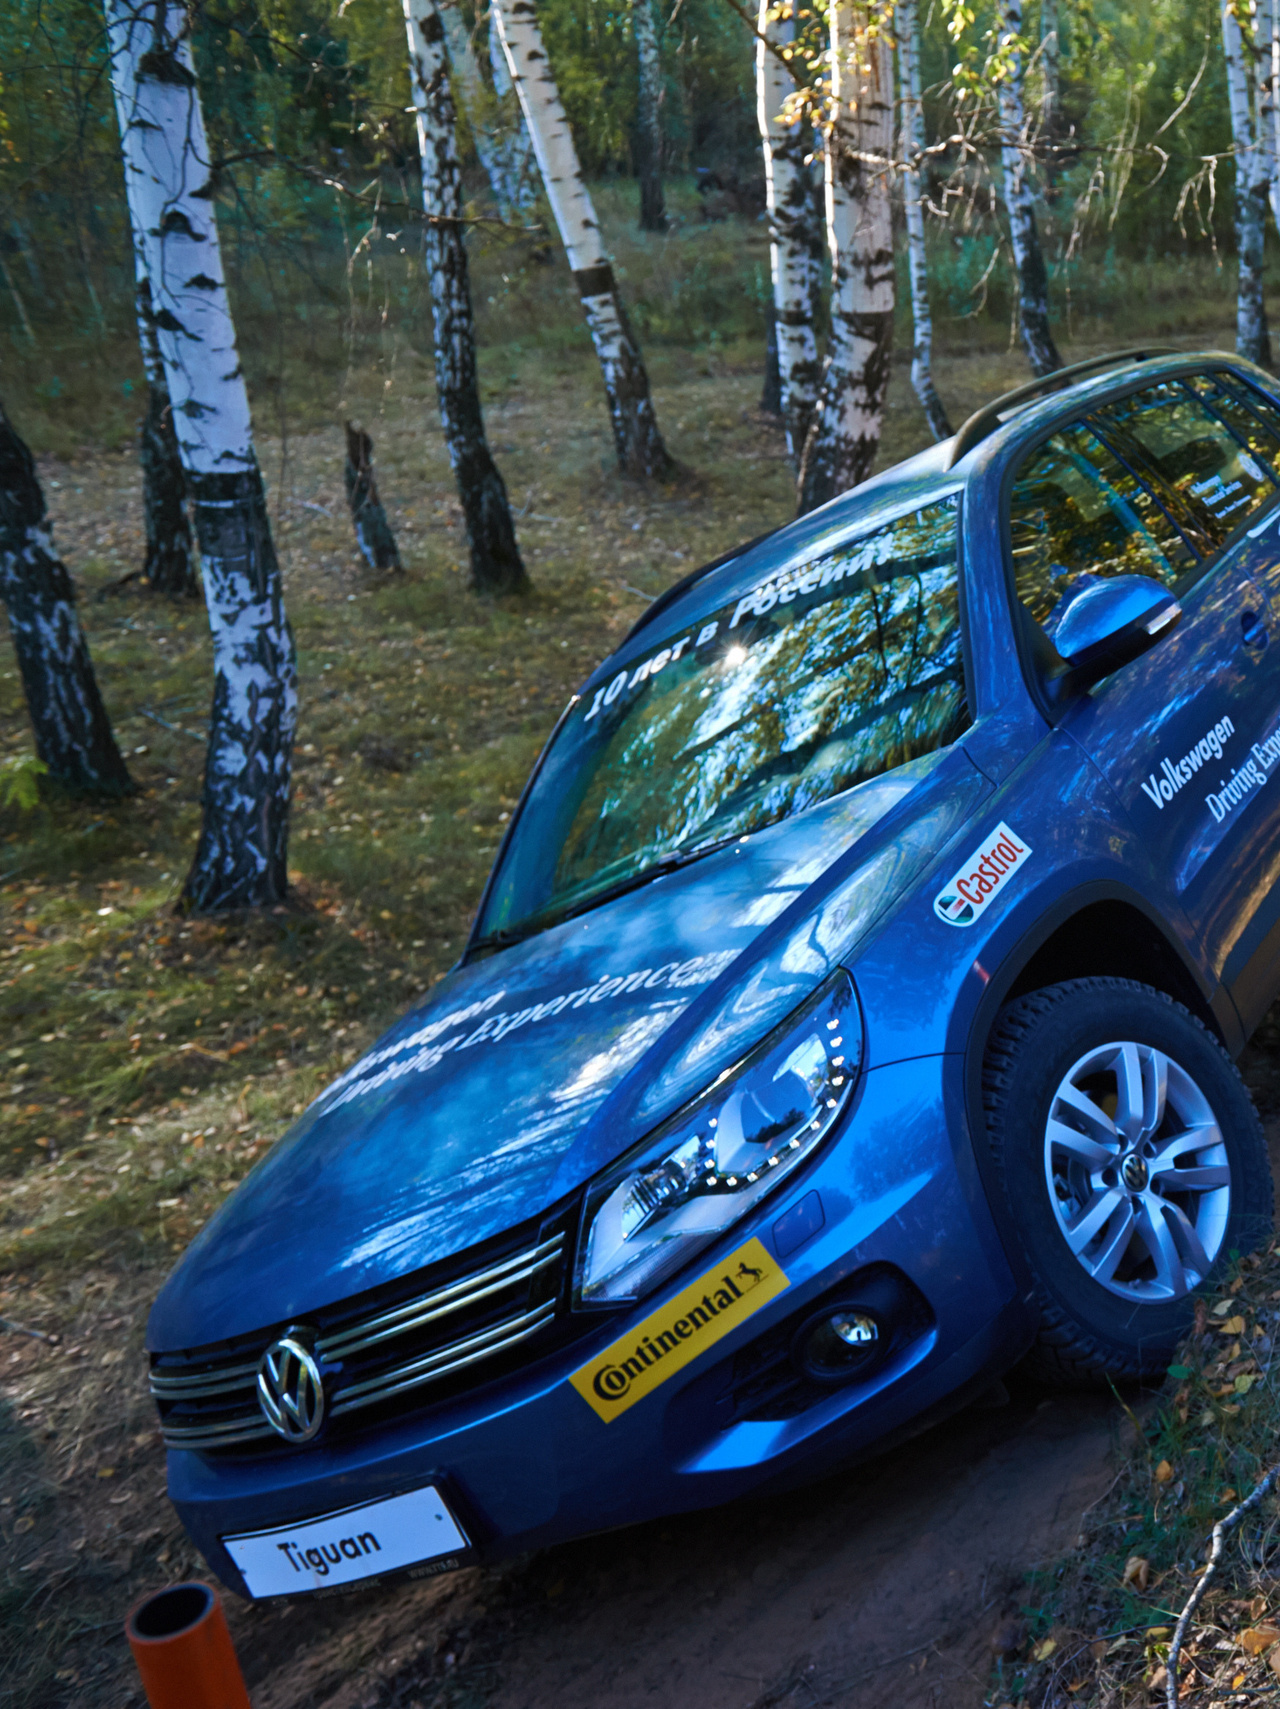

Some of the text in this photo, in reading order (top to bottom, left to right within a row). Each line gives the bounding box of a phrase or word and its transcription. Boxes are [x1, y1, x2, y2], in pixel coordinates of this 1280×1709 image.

[584, 670, 628, 722] 10
[627, 636, 691, 690] лет
[695, 621, 719, 647] в
[1140, 714, 1236, 810] Volkswagen
[1205, 759, 1268, 823] Driving
[956, 832, 1024, 906] Castrol
[455, 956, 704, 1052] Experience
[591, 1275, 744, 1402] Continental
[277, 1529, 382, 1577] Tiguan
